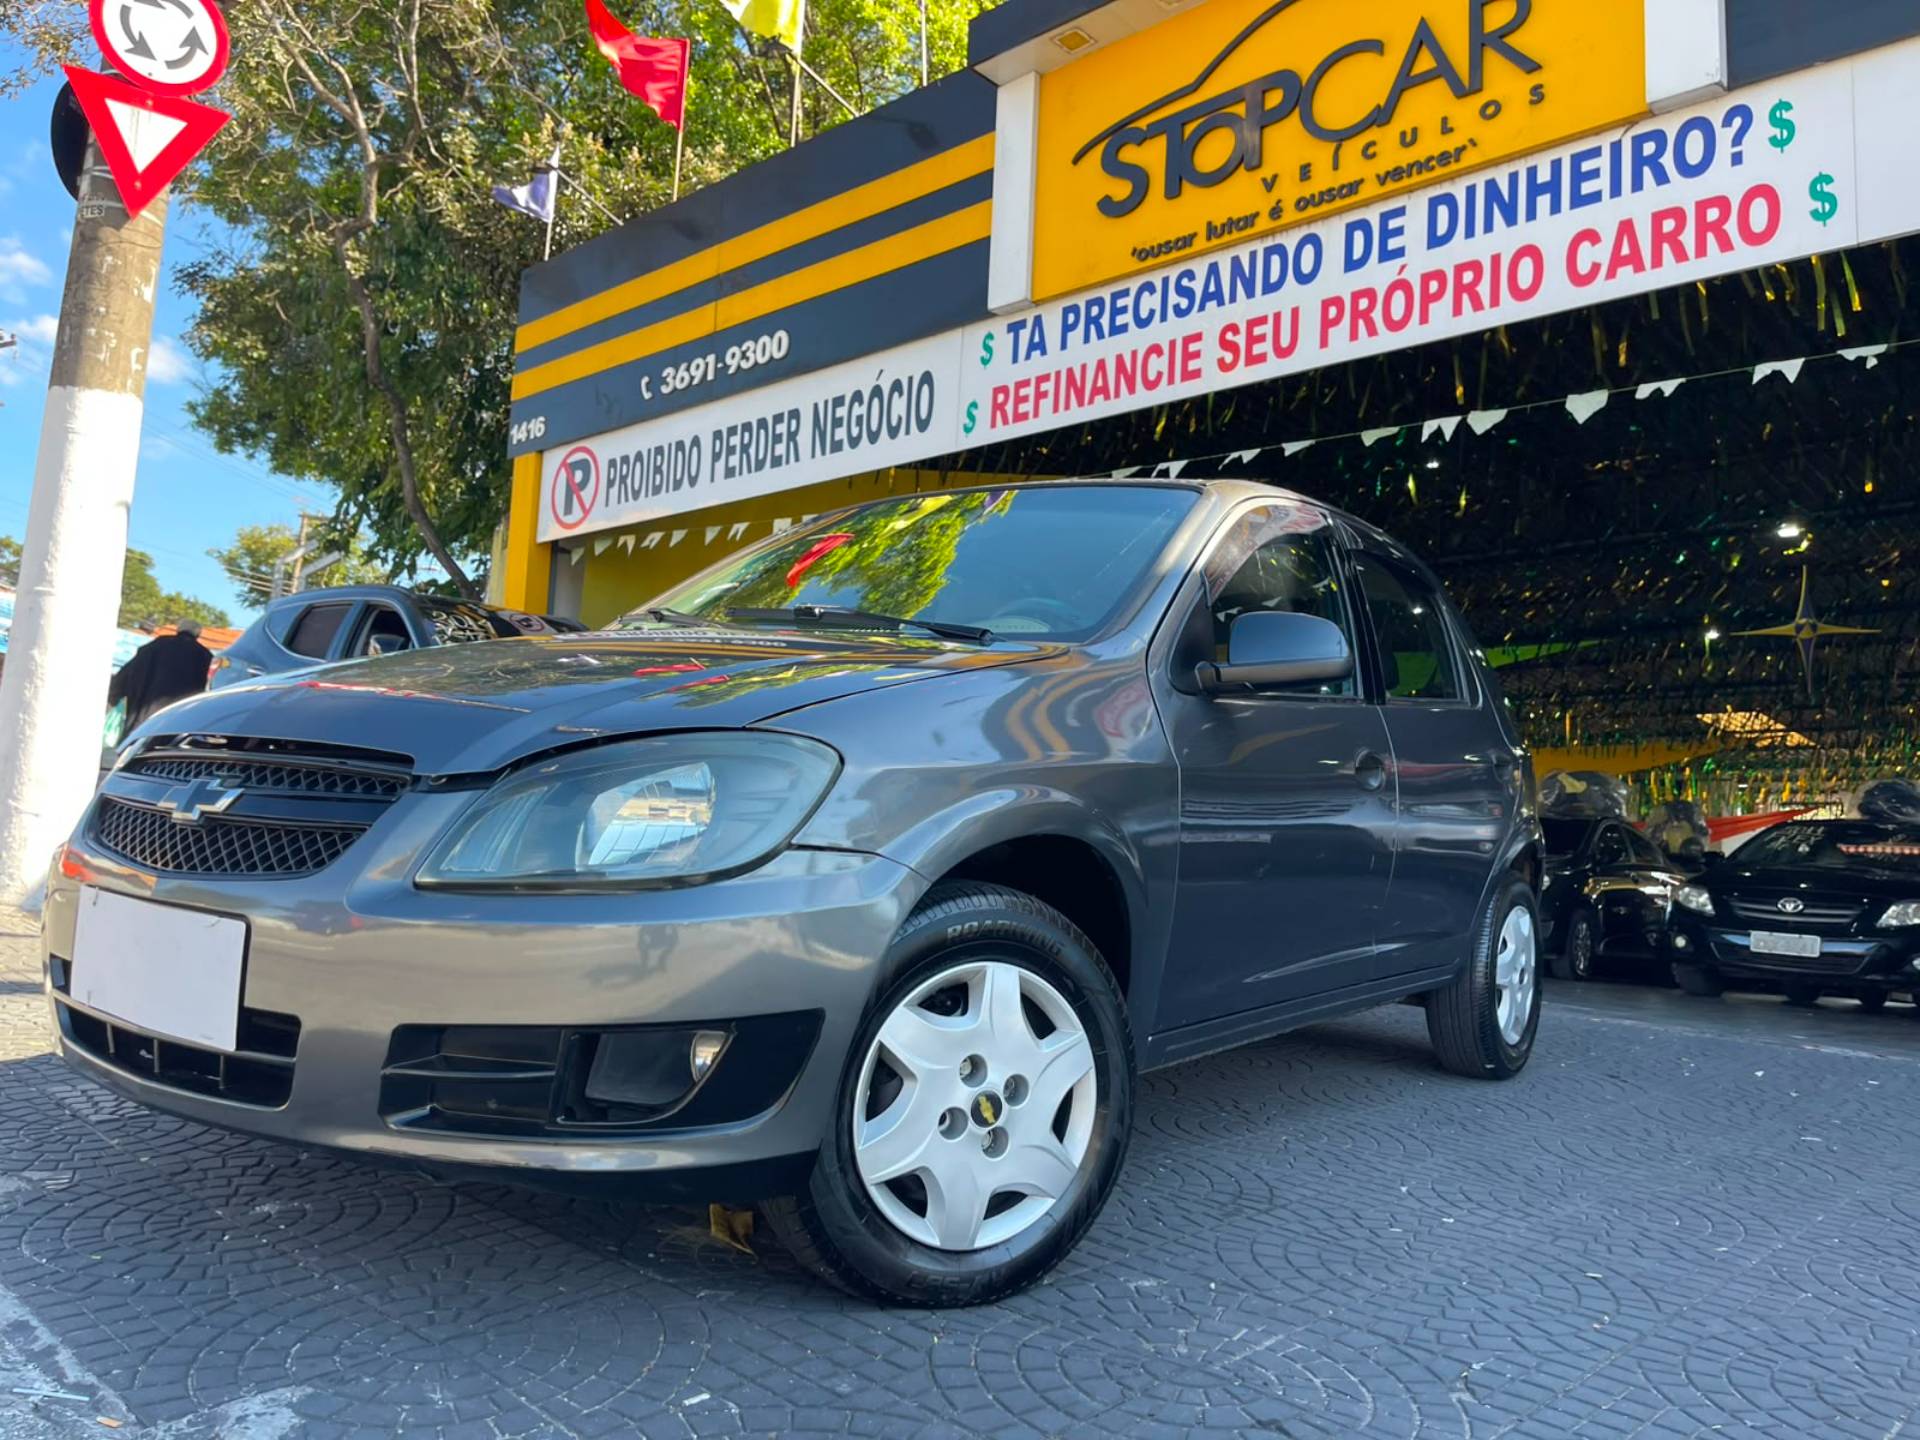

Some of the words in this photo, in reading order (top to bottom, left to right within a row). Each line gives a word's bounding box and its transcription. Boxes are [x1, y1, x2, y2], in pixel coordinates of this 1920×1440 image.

[1097, 0, 1543, 218] STOPCAR
[1261, 84, 1545, 193] VEÍCULOS
[1006, 313, 1048, 365] TA
[1060, 232, 1324, 351] PRECISANDO
[1343, 205, 1407, 273] DE
[1426, 103, 1755, 251] DINHEIRO?
[1206, 209, 1260, 241] lutar
[1269, 200, 1284, 221] é
[1294, 177, 1365, 213] ousar
[660, 329, 790, 394] 3691-9300
[989, 331, 1203, 429] REFINANCIE
[1216, 306, 1301, 374] SEU
[1319, 243, 1545, 349] PRÓPRIO
[1565, 183, 1782, 288] CARRO
[510, 416, 546, 445] 1416
[604, 437, 701, 508] PROIBIDO
[710, 408, 801, 483] PERDER
[810, 369, 935, 459] NEGÓCIO
